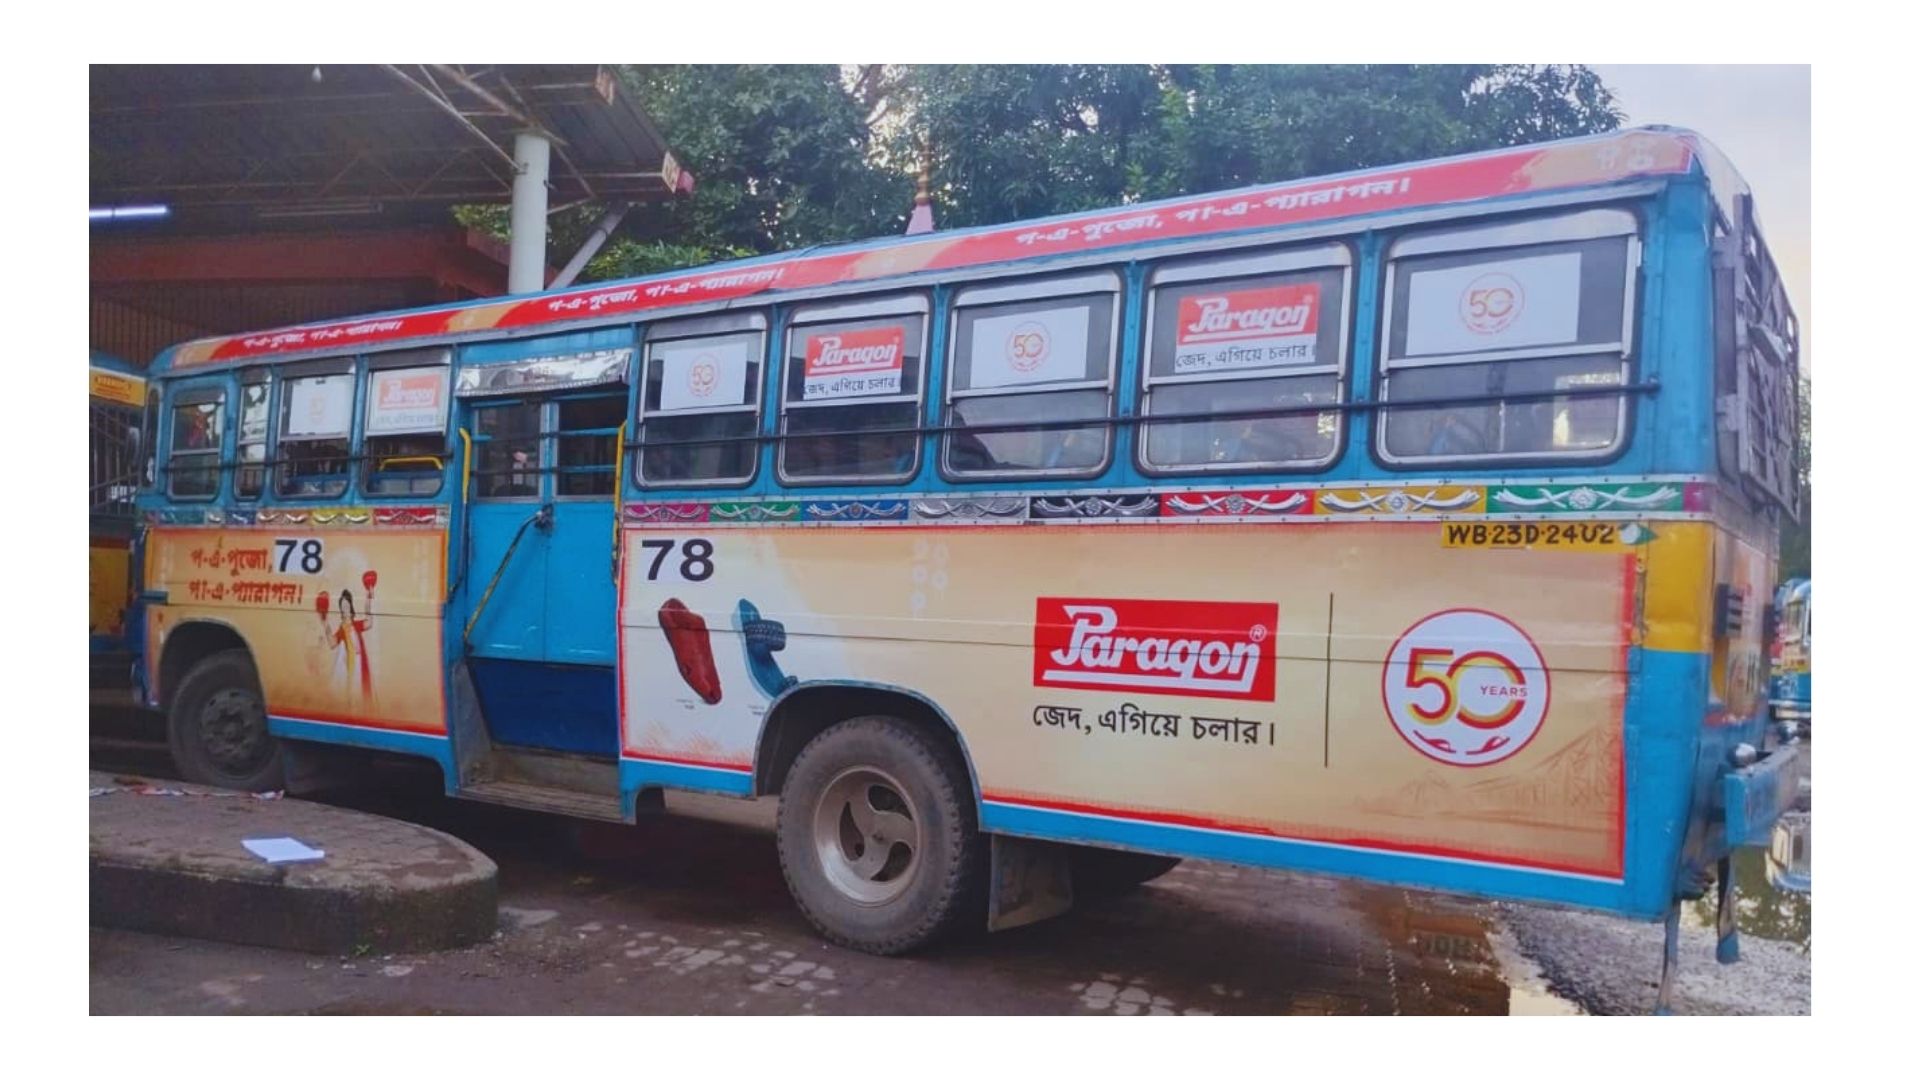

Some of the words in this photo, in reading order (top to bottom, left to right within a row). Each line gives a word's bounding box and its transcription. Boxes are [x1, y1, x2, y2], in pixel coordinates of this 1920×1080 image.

[1187, 297, 1310, 338] Paragon
[812, 336, 898, 371] Paragon
[274, 539, 323, 574] 78
[641, 537, 715, 581] 78
[1050, 605, 1261, 692] Paragon
[1406, 647, 1527, 730] 50
[1480, 684, 1528, 698] YEARS
[1032, 704, 1092, 735] জেদ,
[1098, 702, 1182, 738] এগিয়ে
